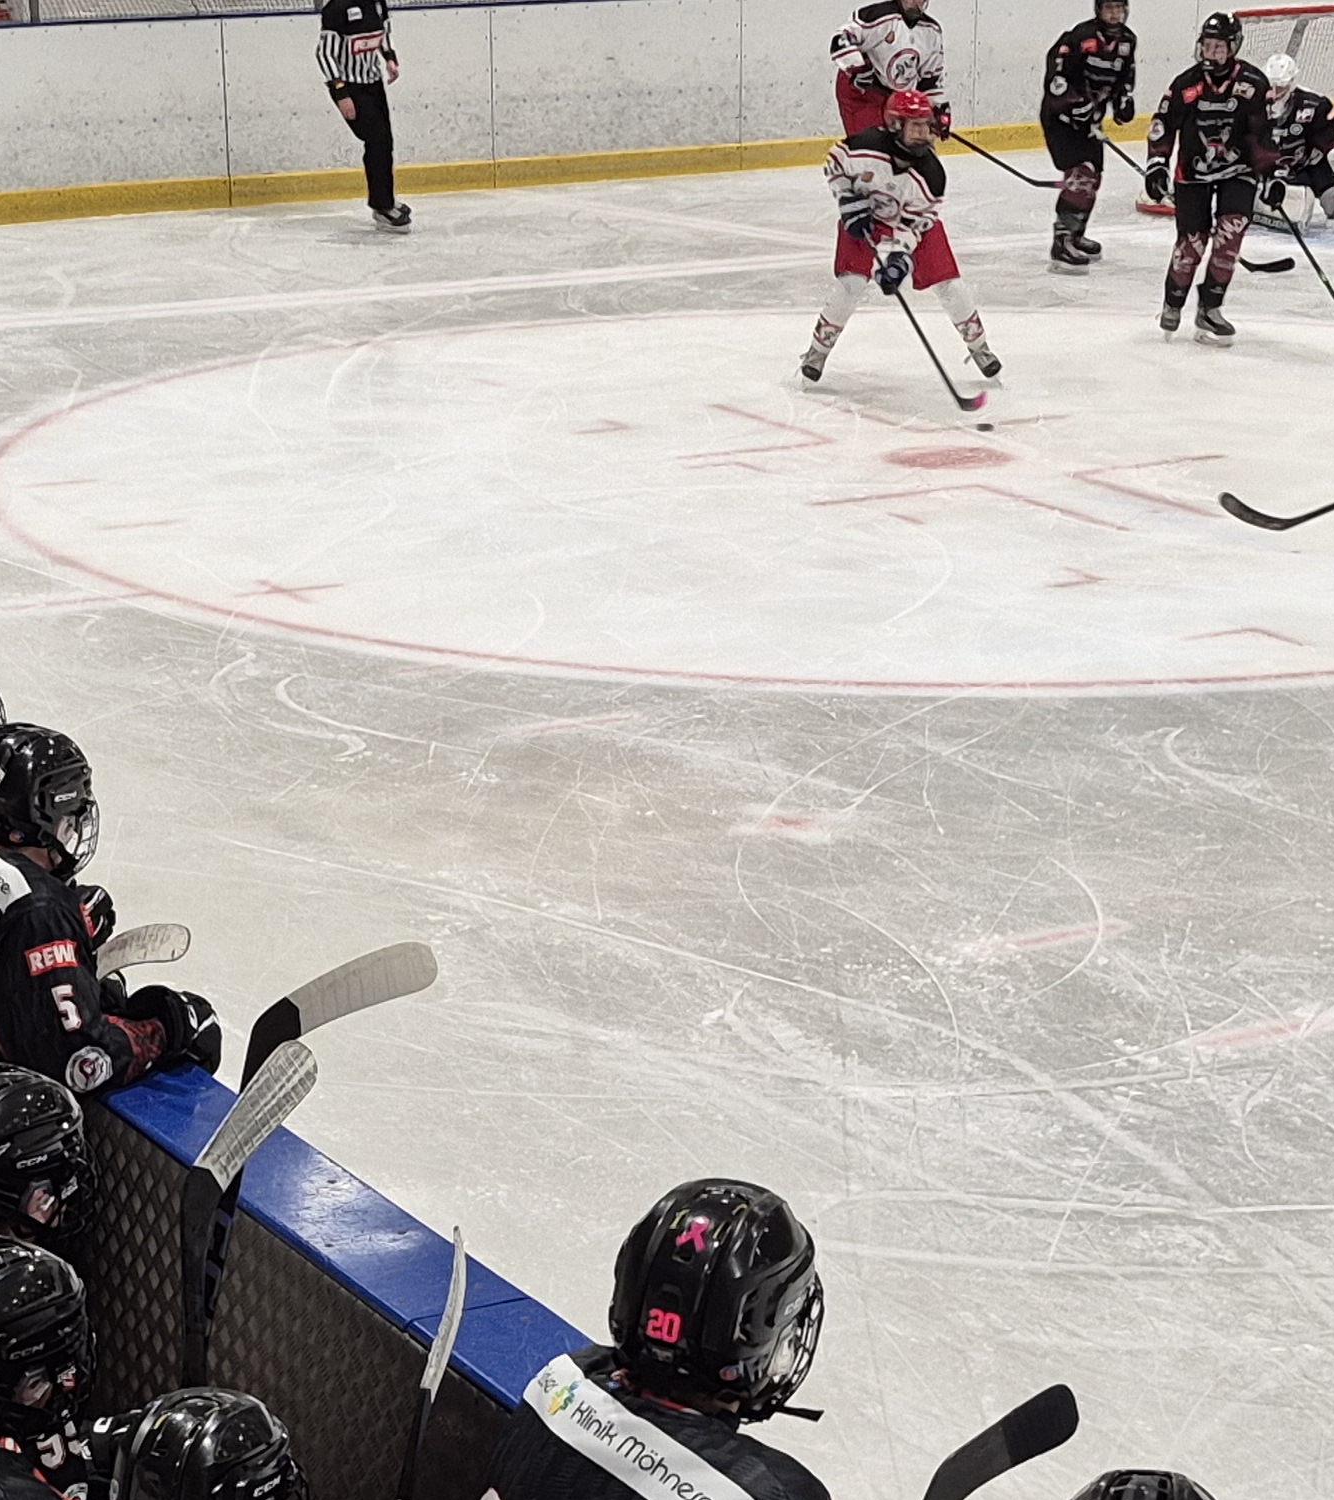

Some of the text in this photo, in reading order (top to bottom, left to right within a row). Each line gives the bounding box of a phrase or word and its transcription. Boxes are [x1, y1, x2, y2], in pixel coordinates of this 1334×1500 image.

[51, 985, 82, 1032] 5
[646, 1308, 682, 1344] 20
[571, 1400, 618, 1447] Klinik
[253, 1475, 281, 1497] CCM
